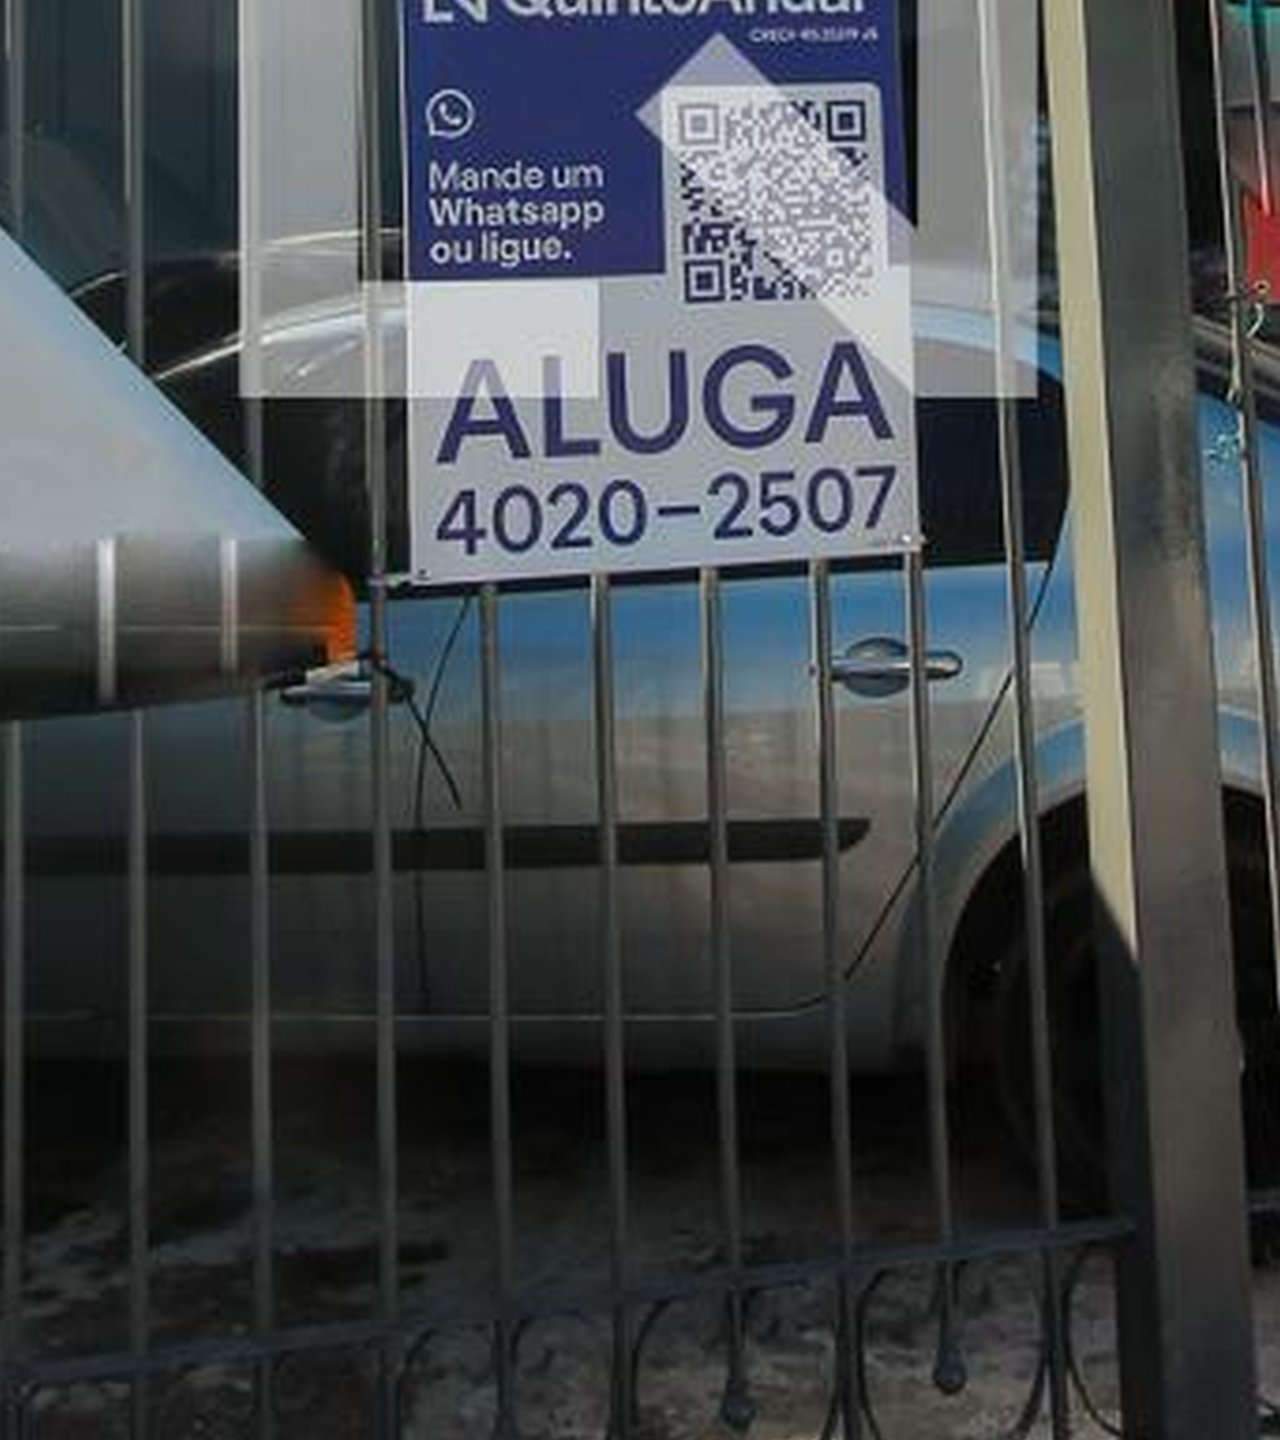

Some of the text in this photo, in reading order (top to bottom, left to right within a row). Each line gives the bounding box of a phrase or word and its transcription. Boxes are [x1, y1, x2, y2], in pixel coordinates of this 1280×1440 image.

[429, 160, 604, 191] Mande um
[429, 197, 605, 230] Whatsapp
[429, 231, 572, 268] ou ligue.
[435, 340, 895, 464] ALUGA
[435, 465, 897, 556] 4020-2507
